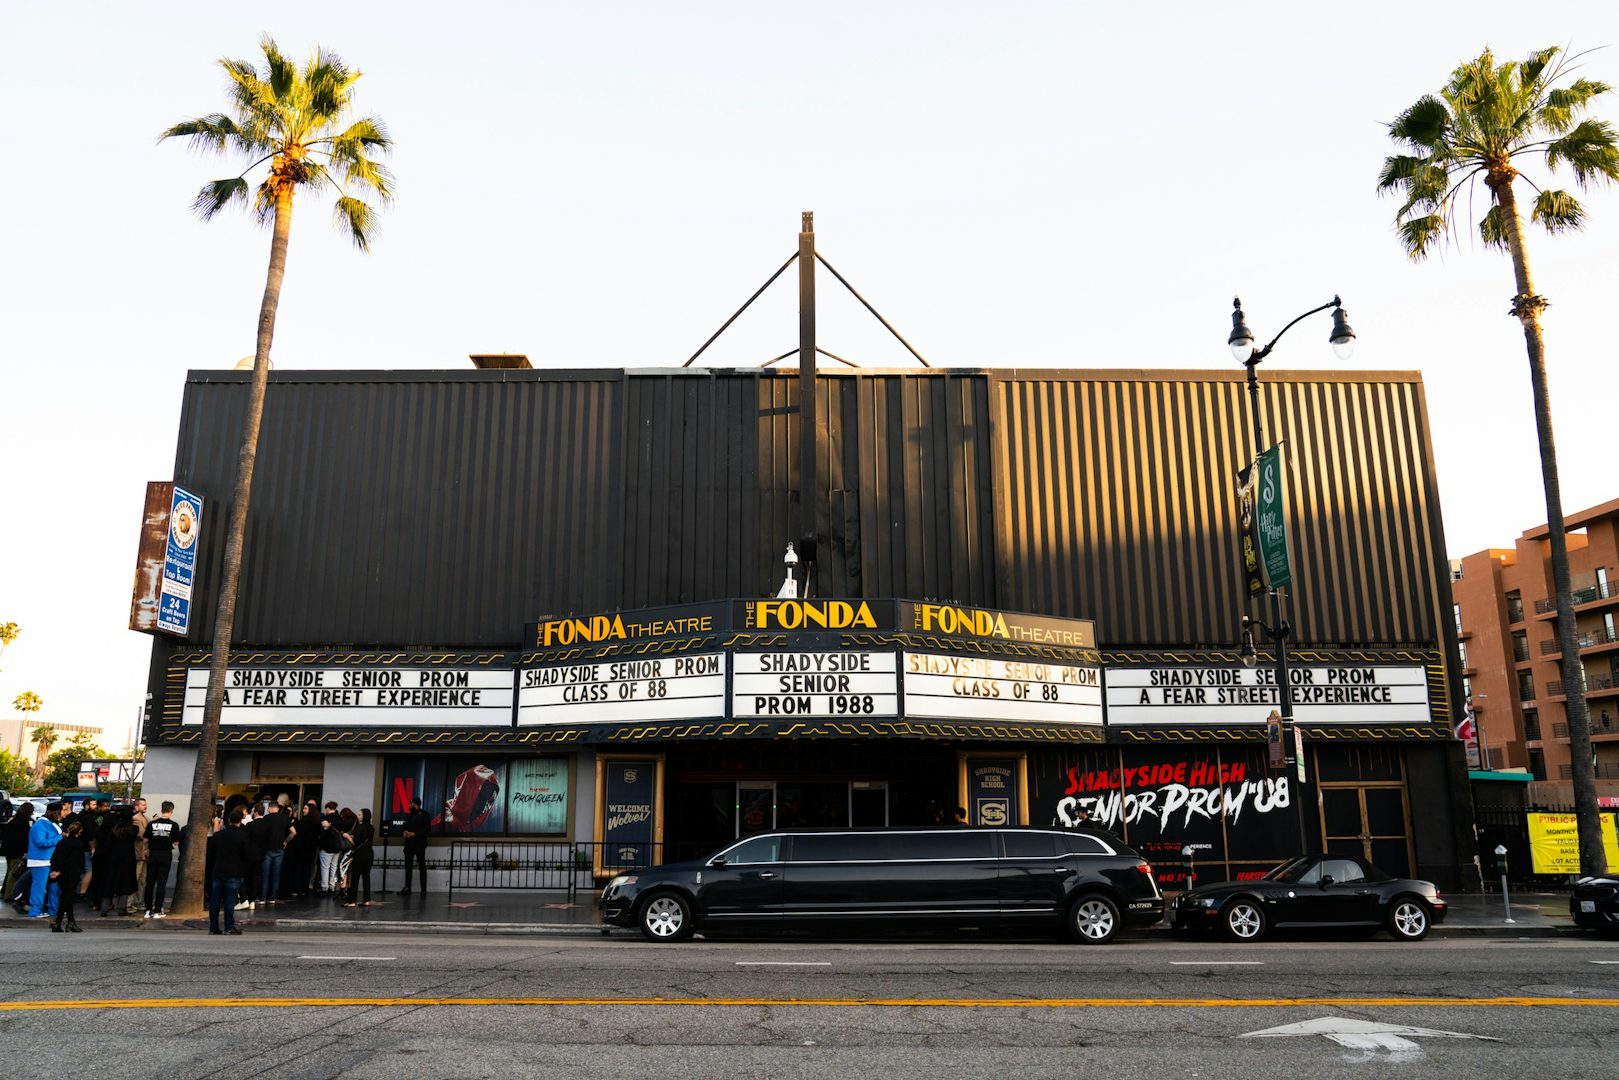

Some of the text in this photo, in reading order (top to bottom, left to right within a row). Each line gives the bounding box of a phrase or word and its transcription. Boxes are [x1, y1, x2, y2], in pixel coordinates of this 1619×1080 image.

[162, 606, 174, 615] Craft
[169, 597, 180, 610] 24
[745, 600, 878, 630] THE FONDA
[914, 603, 1084, 646] THE FONDA THEATRE
[536, 613, 713, 647] THE FONDA THEATRE
[525, 655, 720, 686] SHADYSIDE SENIOR PROM
[760, 654, 870, 672] SHADYSIDE
[909, 653, 993, 678] SHADYSDE
[1062, 667, 1097, 685] PROM
[232, 670, 469, 688] SHADYSIDE SENIOR PROM
[779, 675, 850, 693] SENIOR
[1150, 668, 1376, 686] SHADYSIDE SEOR PROM
[243, 689, 287, 706] FEAR
[300, 689, 363, 706] STREET
[376, 690, 481, 706] EXPERIENCE
[563, 679, 667, 703] CLASS OF 88
[952, 678, 1059, 701] CLASS OF 88
[1139, 687, 1392, 704] A FEAR STREET EXPERIENCE
[755, 695, 874, 714] PROM 1988
[1064, 761, 1246, 795] SHADYSIDE HIGH
[392, 777, 414, 814] N
[609, 805, 650, 813] WELCOME
